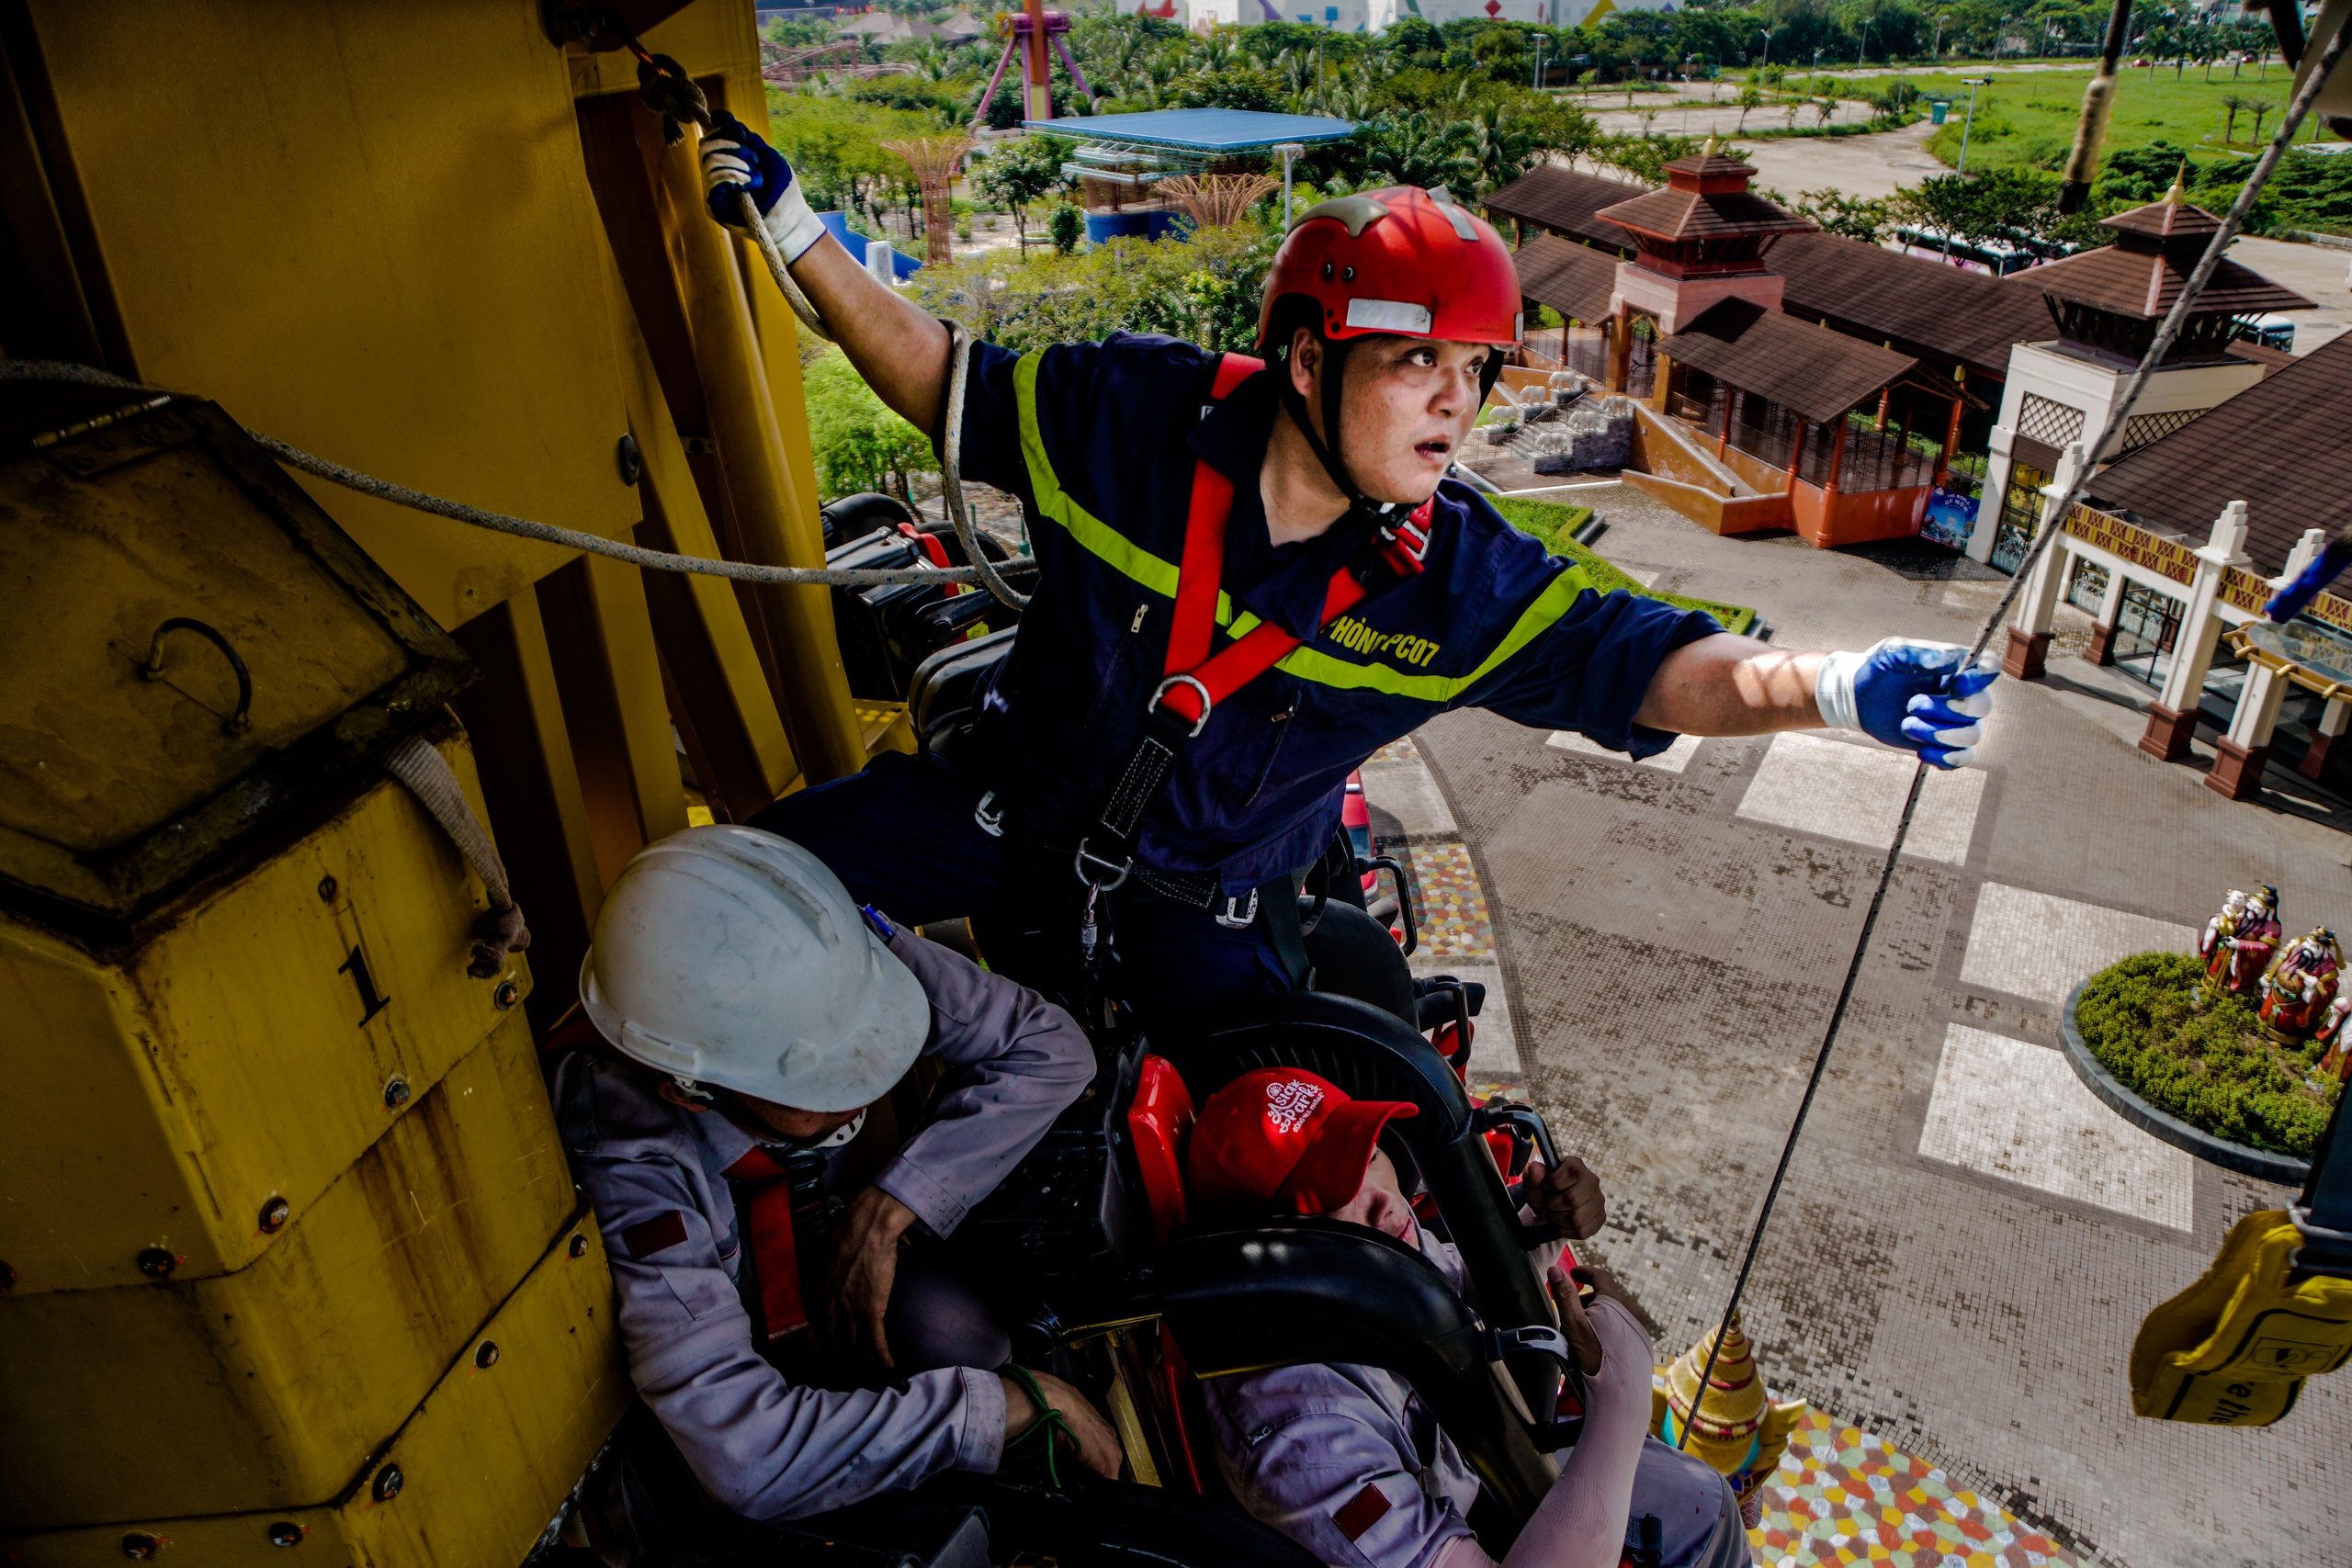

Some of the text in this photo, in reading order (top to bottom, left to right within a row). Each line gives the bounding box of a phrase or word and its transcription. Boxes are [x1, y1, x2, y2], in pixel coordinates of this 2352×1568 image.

[1954, 499, 1969, 512] WOW
[1381, 634, 1441, 667] PC07
[338, 944, 390, 1028] 1
[1268, 1085, 1302, 1124] Asia
[2208, 1399, 2251, 1423] the
